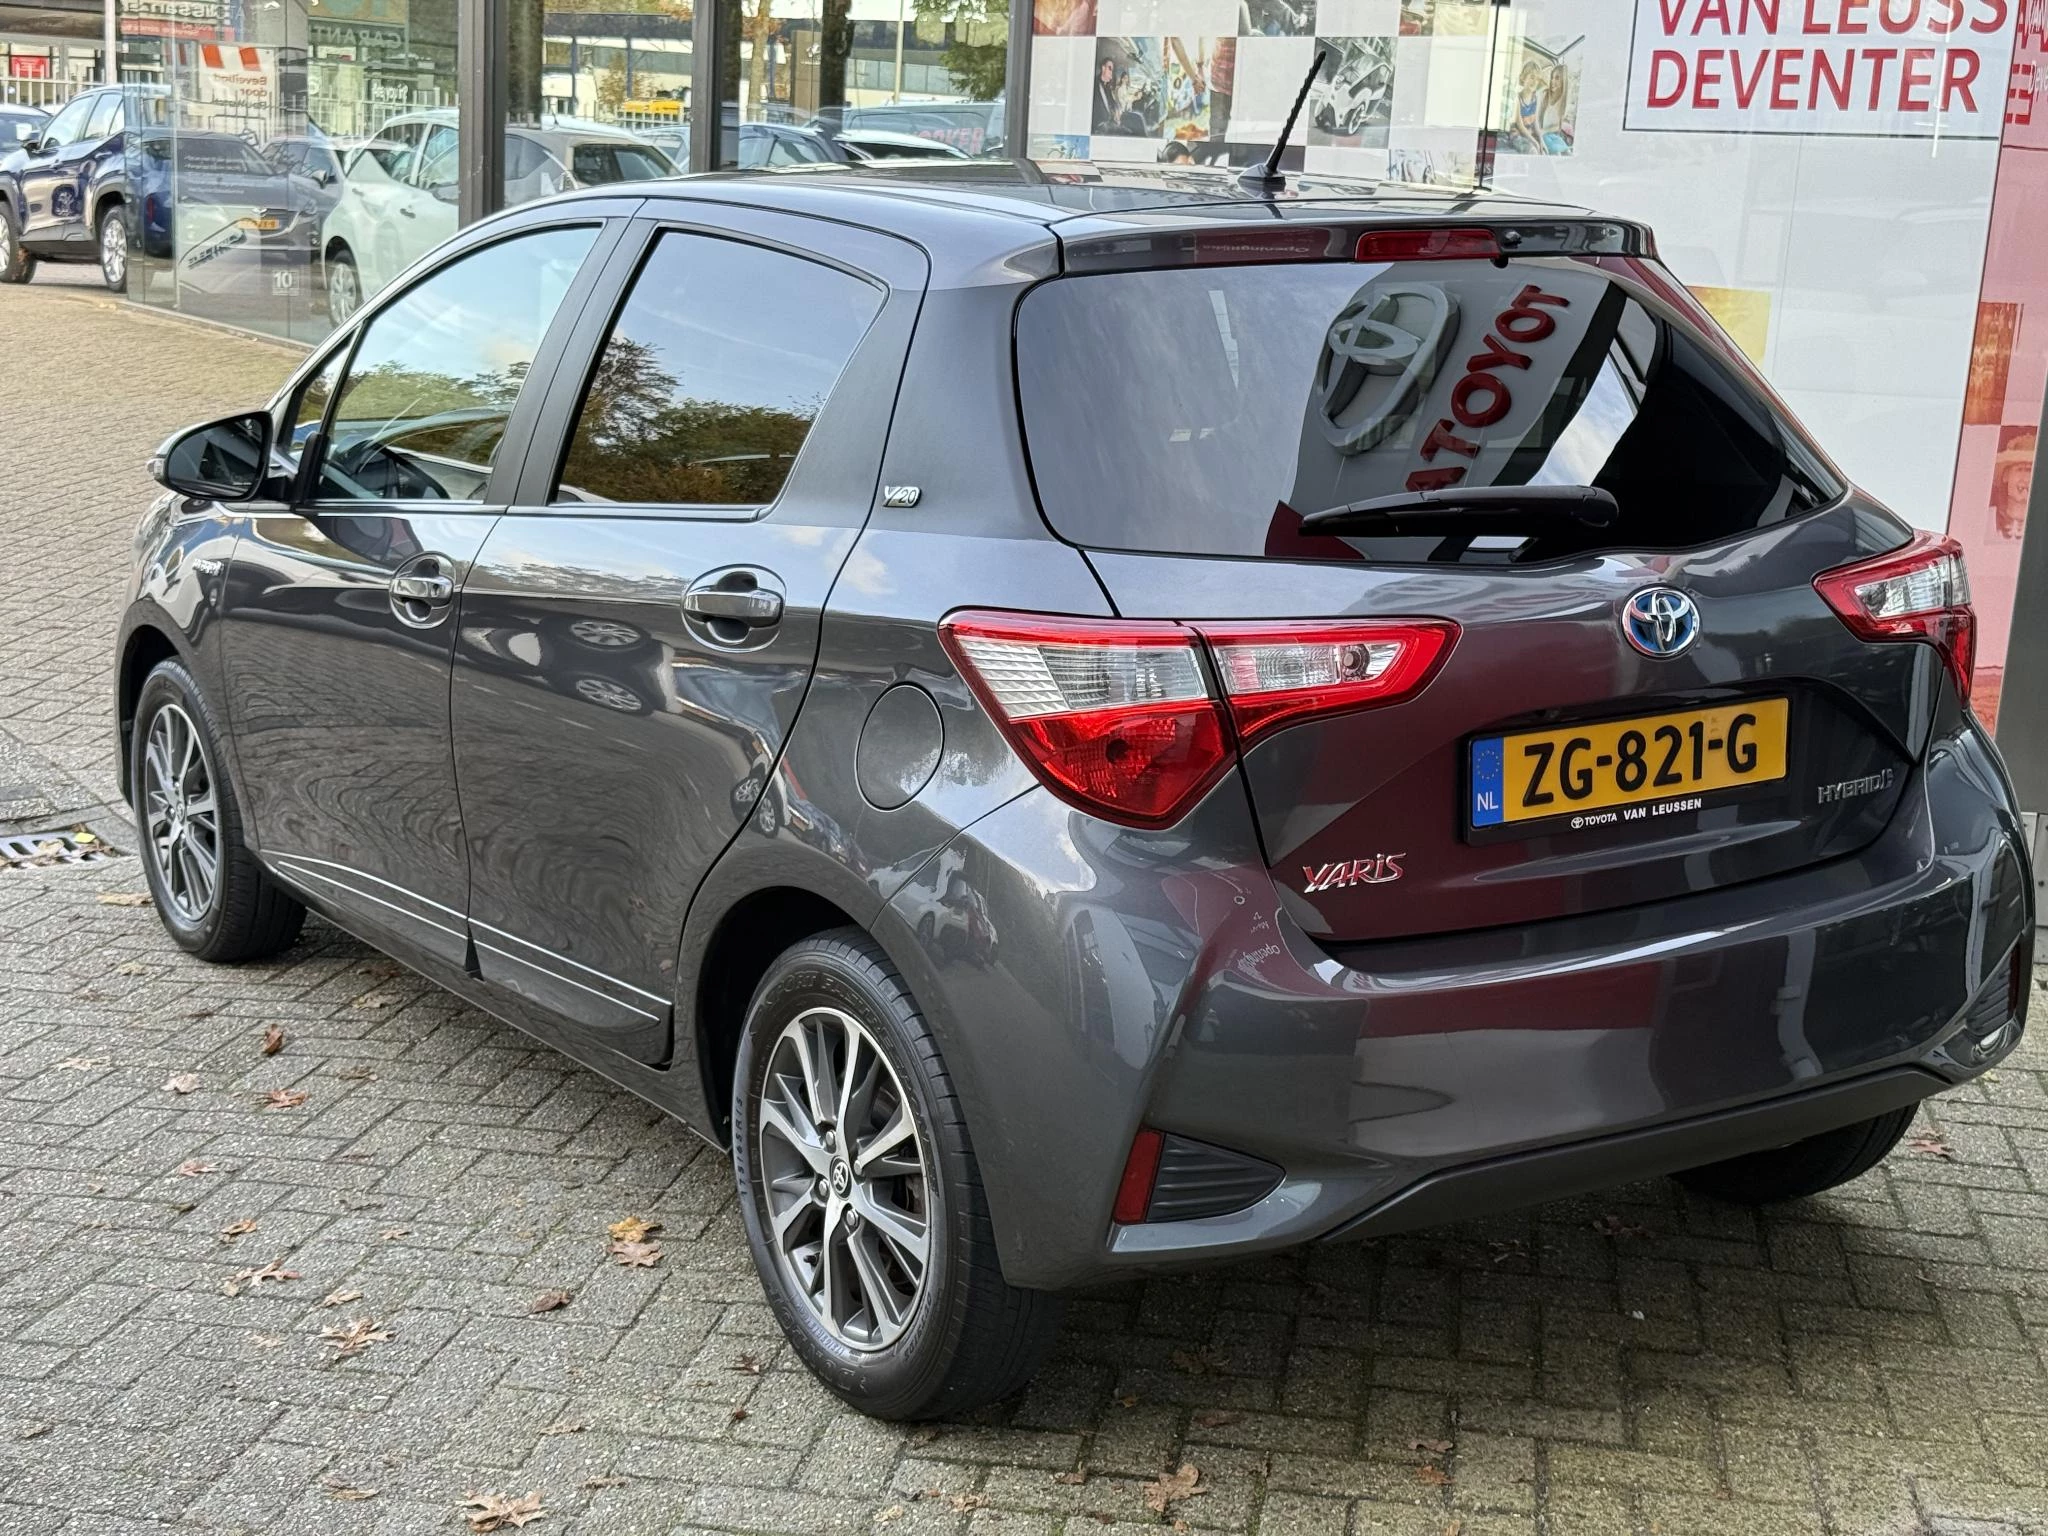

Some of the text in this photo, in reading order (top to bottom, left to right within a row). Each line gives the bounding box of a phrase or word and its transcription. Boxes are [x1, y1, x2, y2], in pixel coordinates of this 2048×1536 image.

[1658, 0, 1783, 36] VAN
[1801, 0, 2009, 36] LEUSS
[1646, 48, 1982, 113] DEVENTER
[1522, 713, 1757, 807] ZG-821-G
[1476, 792, 1499, 812] NL
[1585, 798, 1702, 827] TOYOTA VAN LEUSSEN
